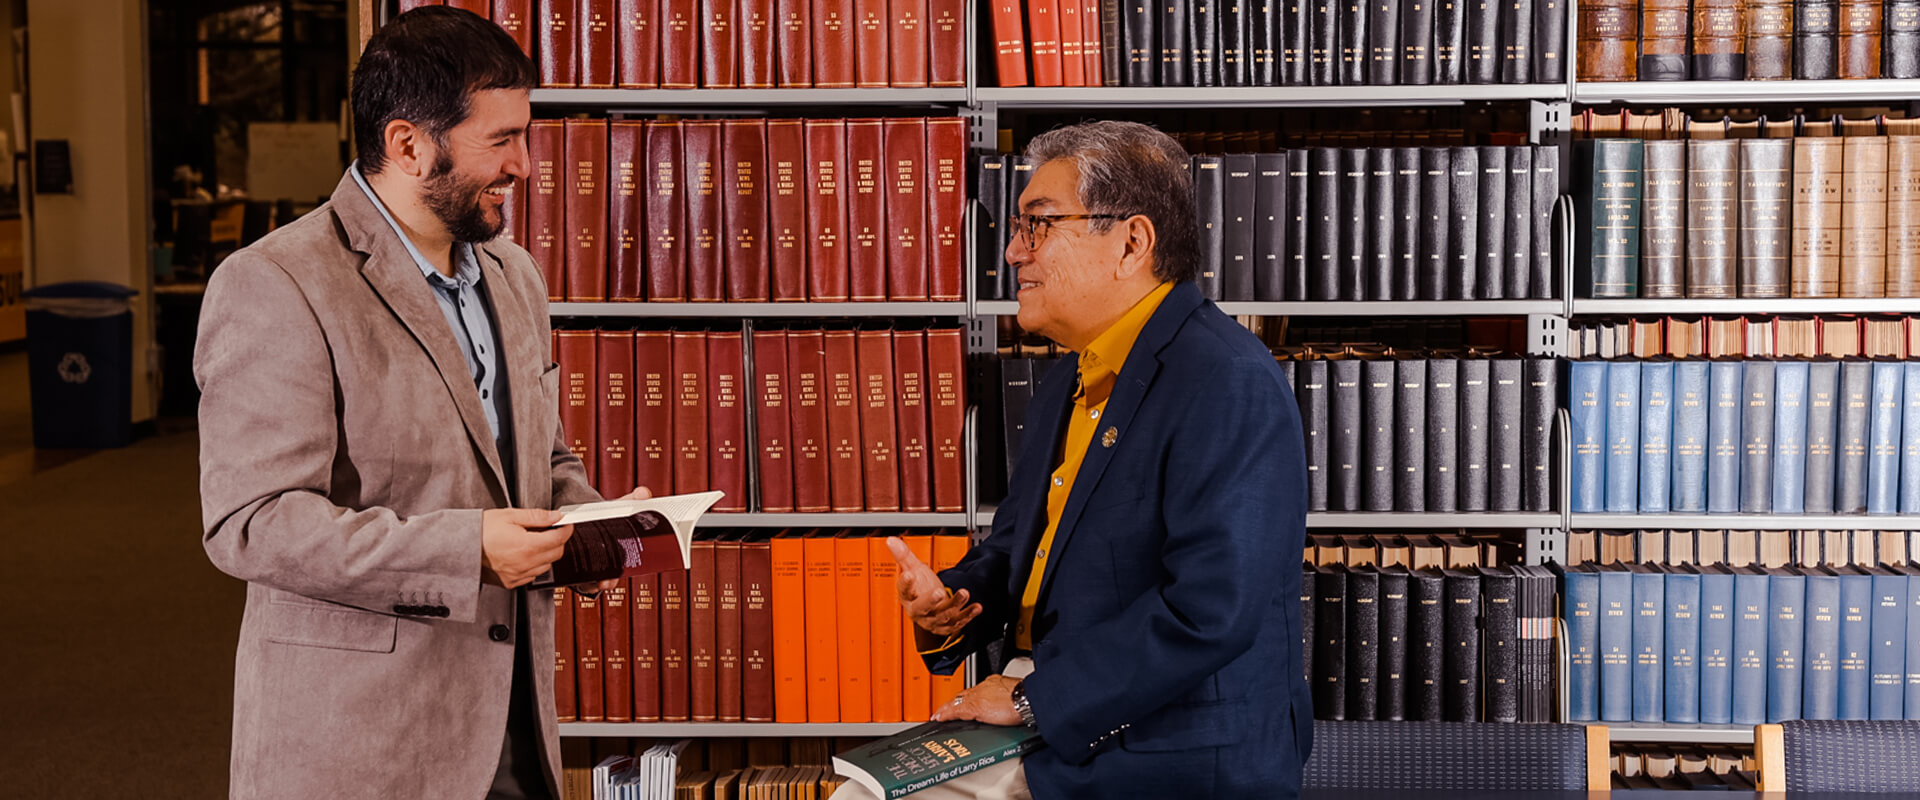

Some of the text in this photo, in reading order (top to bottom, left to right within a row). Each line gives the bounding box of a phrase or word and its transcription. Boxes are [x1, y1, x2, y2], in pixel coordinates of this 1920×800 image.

[922, 740, 955, 763] LARRY
[944, 738, 971, 758] RIOS
[1003, 748, 1016, 757] Alex
[886, 763, 908, 780] THE
[891, 755, 995, 797] The Dream Life of Larry Rios
